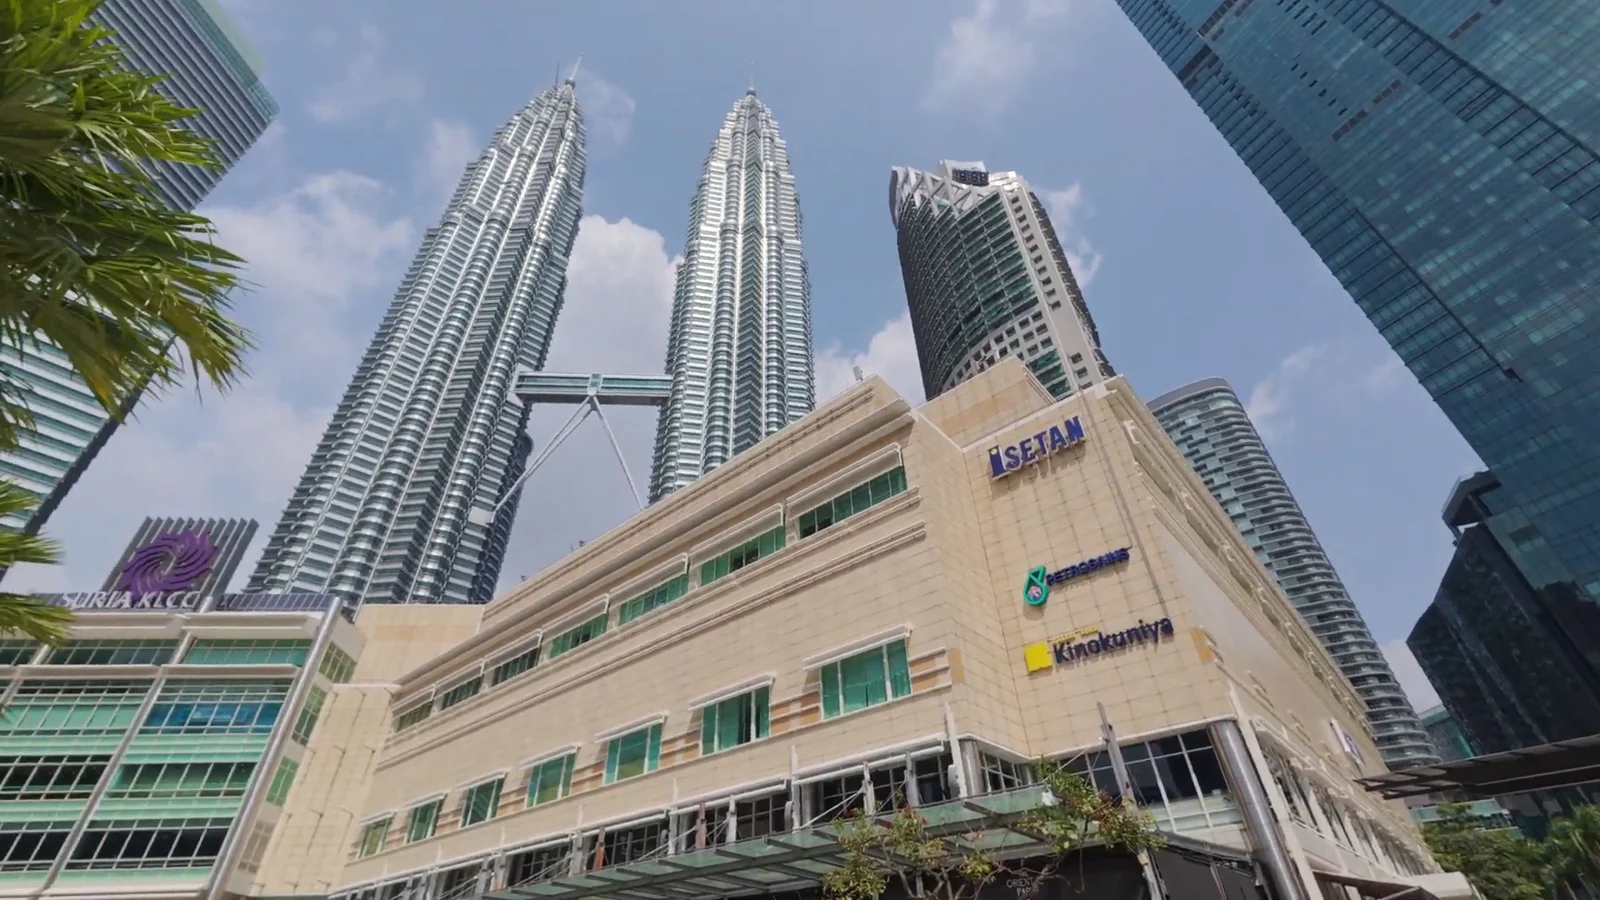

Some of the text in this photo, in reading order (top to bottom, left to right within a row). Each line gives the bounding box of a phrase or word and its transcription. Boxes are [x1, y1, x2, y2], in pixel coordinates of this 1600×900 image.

[988, 415, 1086, 480] ISETAN
[61, 590, 200, 610] SURIA KLCC
[1053, 617, 1174, 664] Kinokuniya
